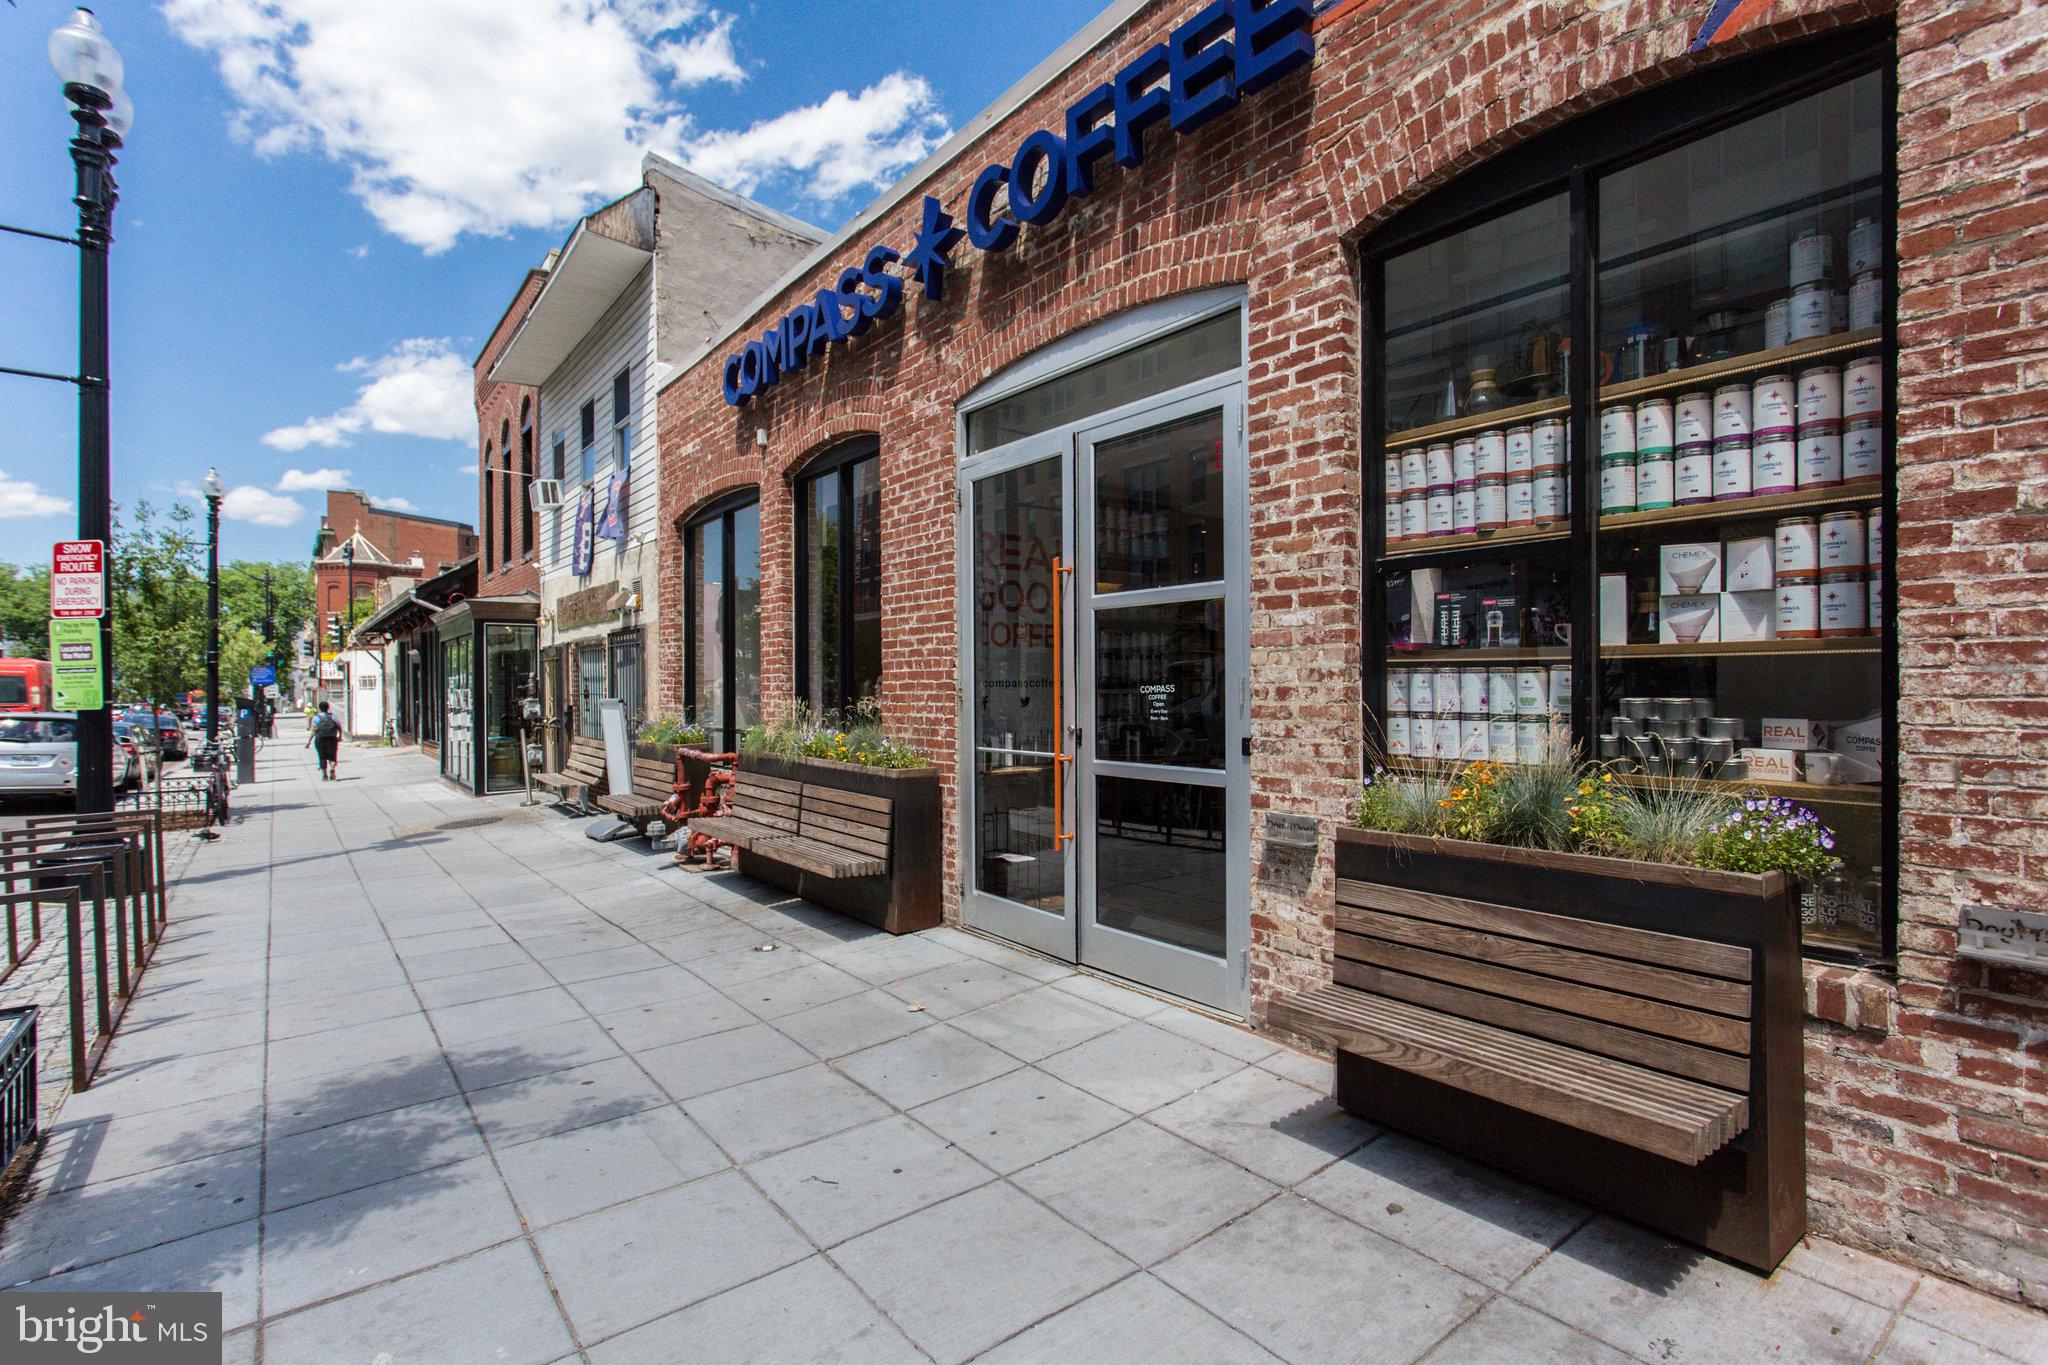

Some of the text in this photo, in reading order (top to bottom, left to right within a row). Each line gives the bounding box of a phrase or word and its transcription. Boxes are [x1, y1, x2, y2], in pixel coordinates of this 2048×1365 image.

[723, 0, 1315, 407] COMPASS COFFEE
[62, 543, 93, 554] SNOW
[56, 553, 99, 561] EMERGENCY
[1672, 550, 1708, 559] CHEMEX
[60, 561, 96, 572] ROUTE
[56, 576, 99, 585] NO PARKING
[65, 587, 92, 596] DURING
[980, 577, 1063, 614] GOO
[56, 597, 99, 606] EMERGENCY
[1670, 601, 1706, 609] CHEMEX
[981, 621, 1063, 648] OFFE
[1140, 684, 1176, 694] COMPASS
[240, 709, 248, 718] P
[1763, 725, 1806, 738] REAL
[1855, 745, 1877, 753] COFFEE
[1744, 756, 1789, 769] REAL
